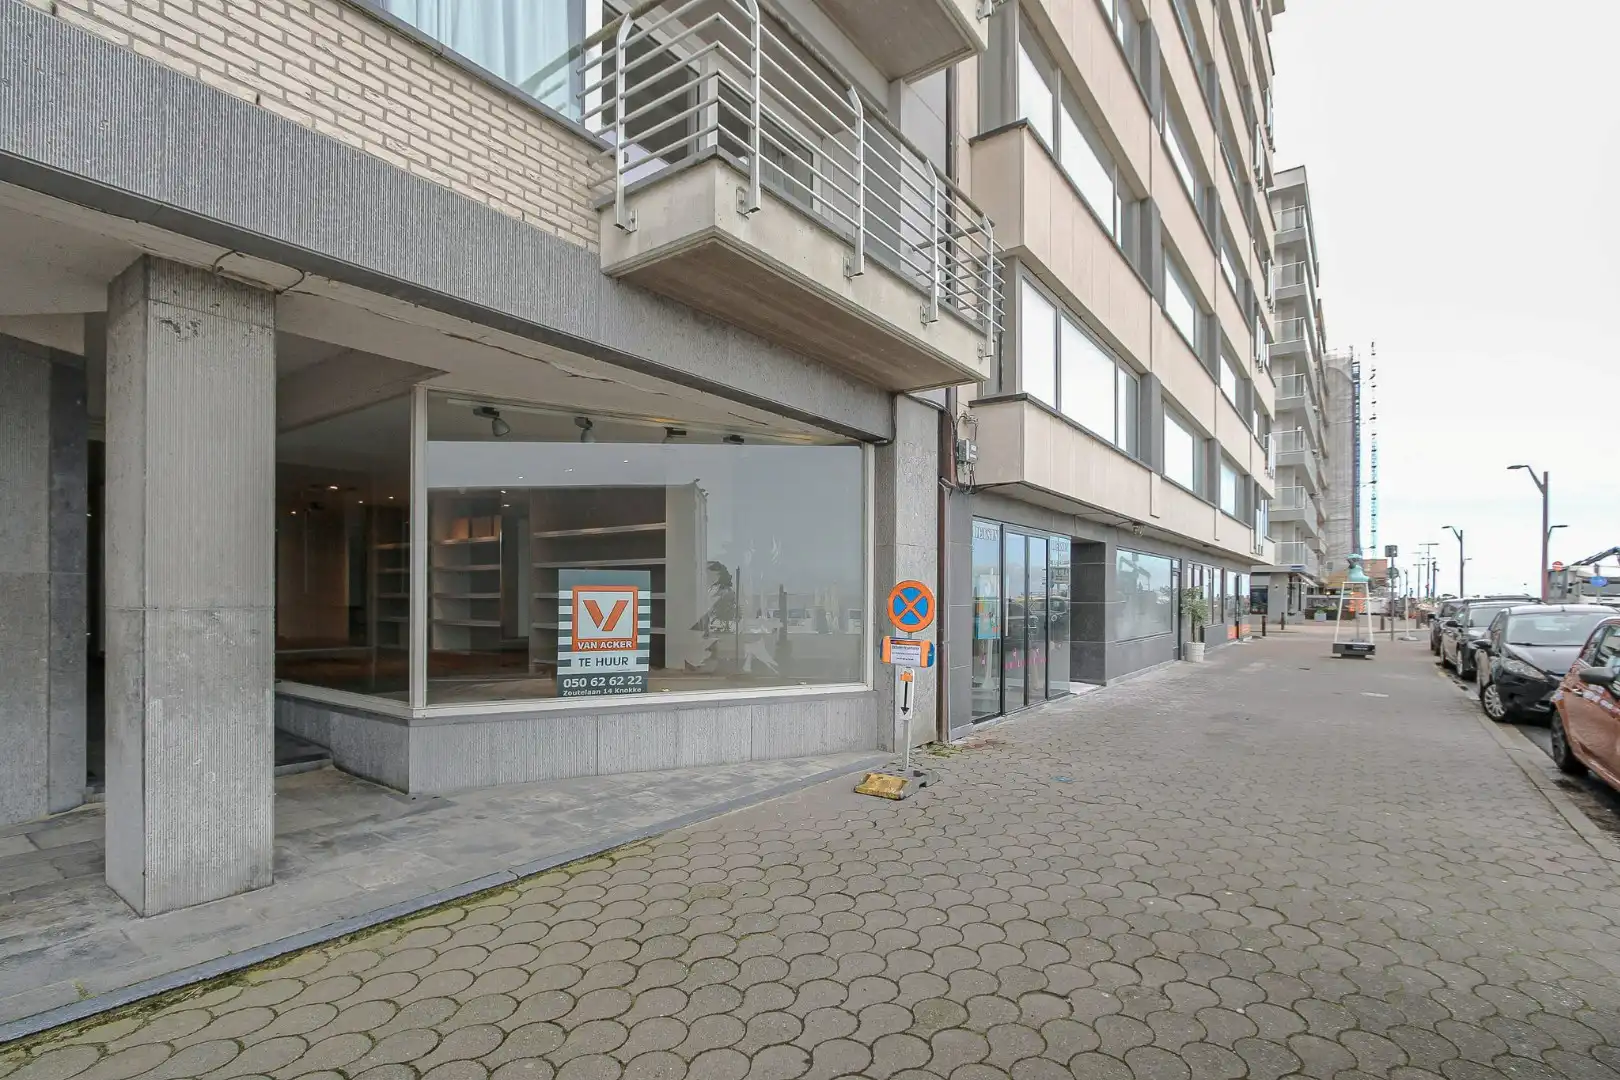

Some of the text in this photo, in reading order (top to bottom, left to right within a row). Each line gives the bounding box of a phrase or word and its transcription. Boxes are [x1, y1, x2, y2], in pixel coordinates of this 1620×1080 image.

[577, 640, 632, 650] VAN ACKER
[578, 657, 629, 667] TE HUUR
[563, 675, 642, 688] 050 62 62 22
